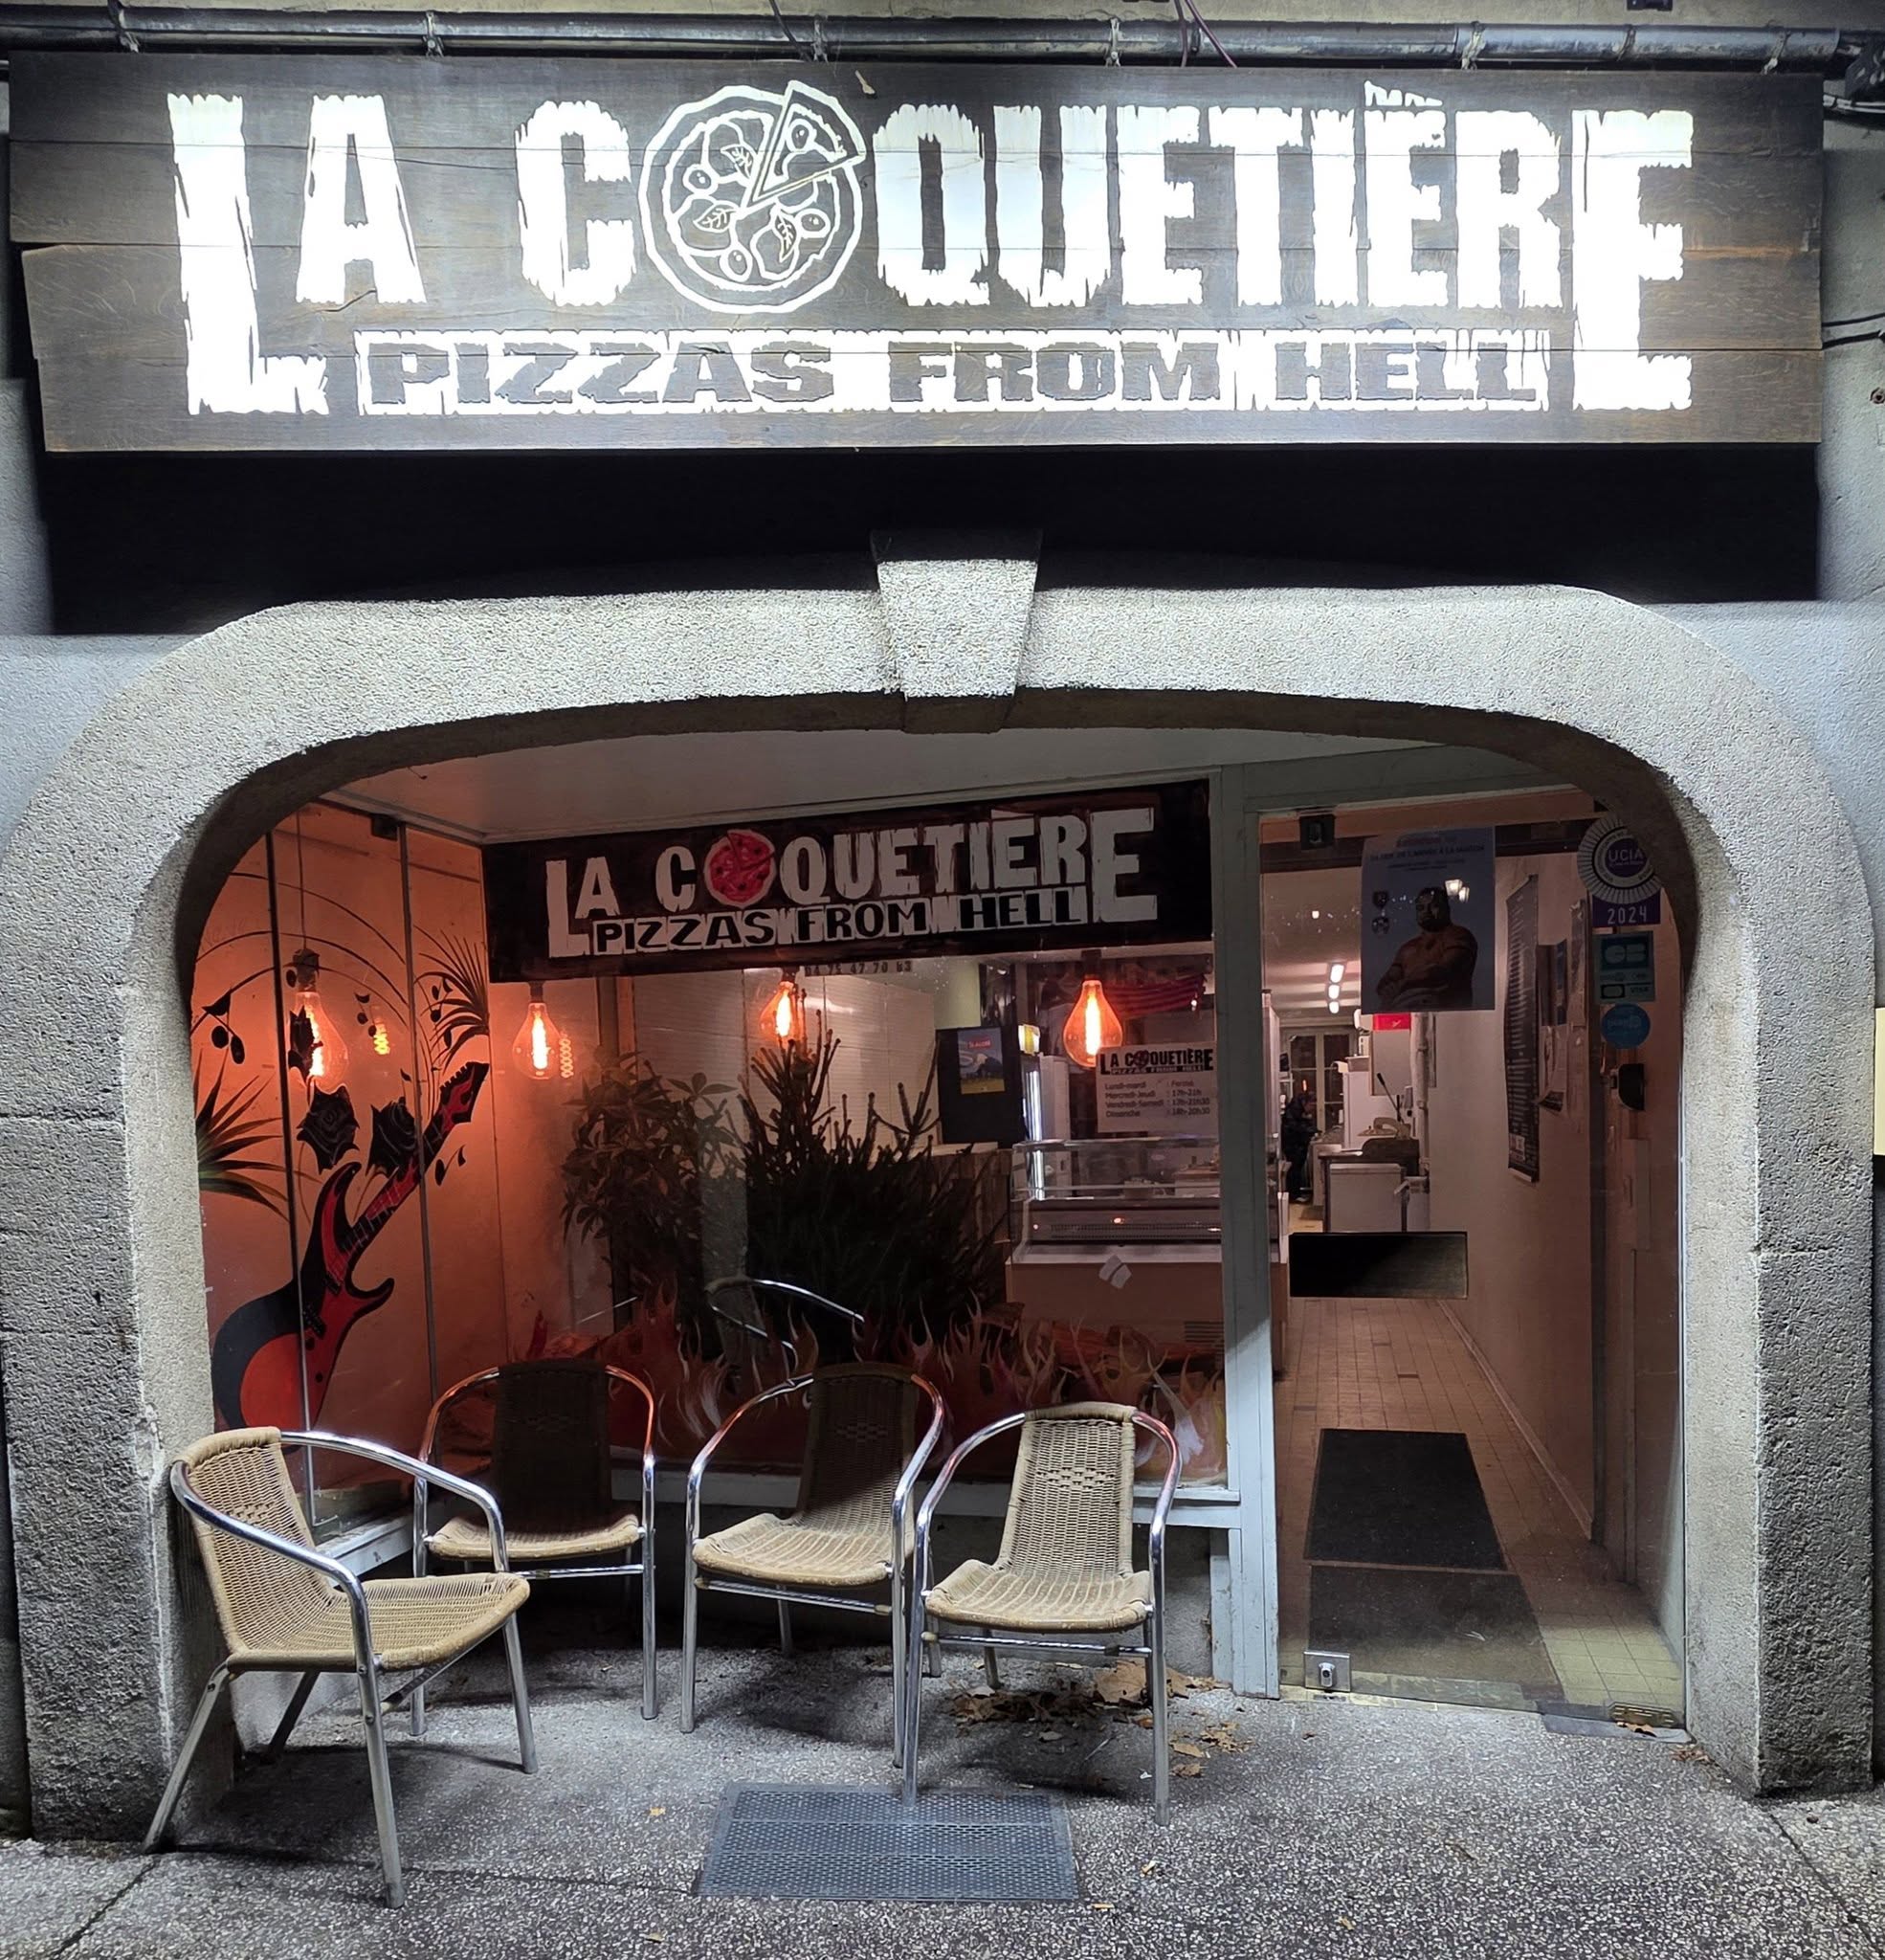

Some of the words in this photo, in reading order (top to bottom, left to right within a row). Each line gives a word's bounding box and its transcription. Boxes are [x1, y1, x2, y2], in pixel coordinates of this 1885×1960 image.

[166, 93, 426, 415] LA
[369, 340, 834, 405] PIZZAS
[889, 340, 1220, 402] FROM
[1275, 341, 1538, 402] HELL
[1608, 847, 1644, 862] UCIA
[546, 857, 620, 959] LA
[595, 909, 775, 953] PIZZAS
[796, 901, 928, 942] FROM
[958, 890, 1081, 929] HELL
[1608, 904, 1648, 925] 2024
[850, 962, 865, 974] 47
[873, 961, 889, 974] 70
[1099, 1053, 1120, 1075] LA
